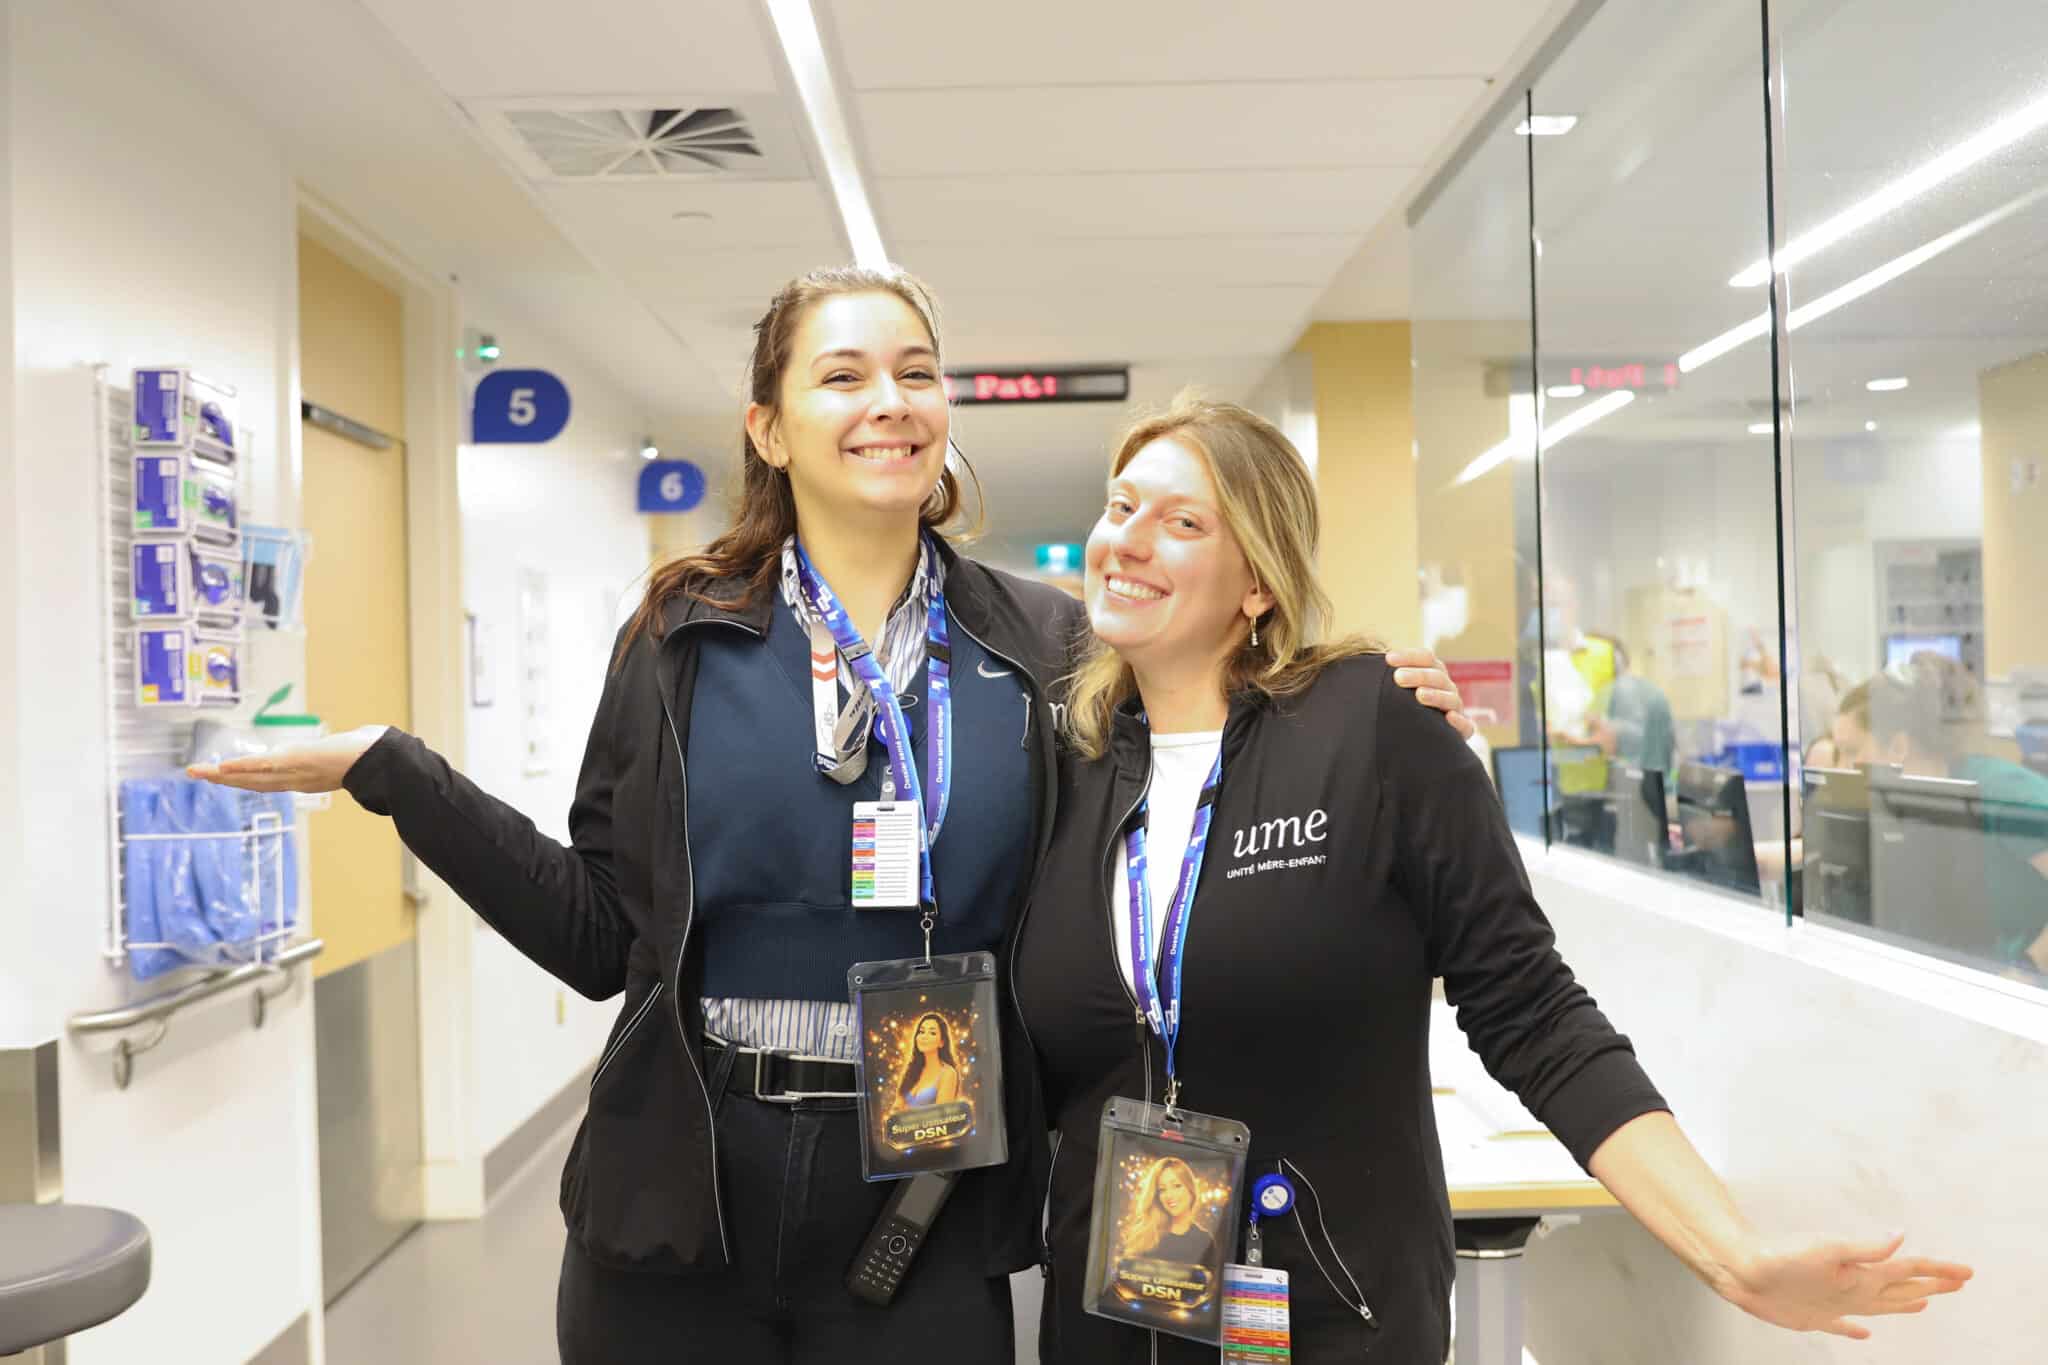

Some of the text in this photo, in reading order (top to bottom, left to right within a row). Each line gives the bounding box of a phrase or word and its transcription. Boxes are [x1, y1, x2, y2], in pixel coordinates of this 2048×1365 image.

[508, 388, 536, 427] 5
[660, 472, 684, 502] 6
[1233, 809, 1328, 858] ume
[914, 1124, 948, 1141] DSN
[1141, 1283, 1182, 1300] DSN
